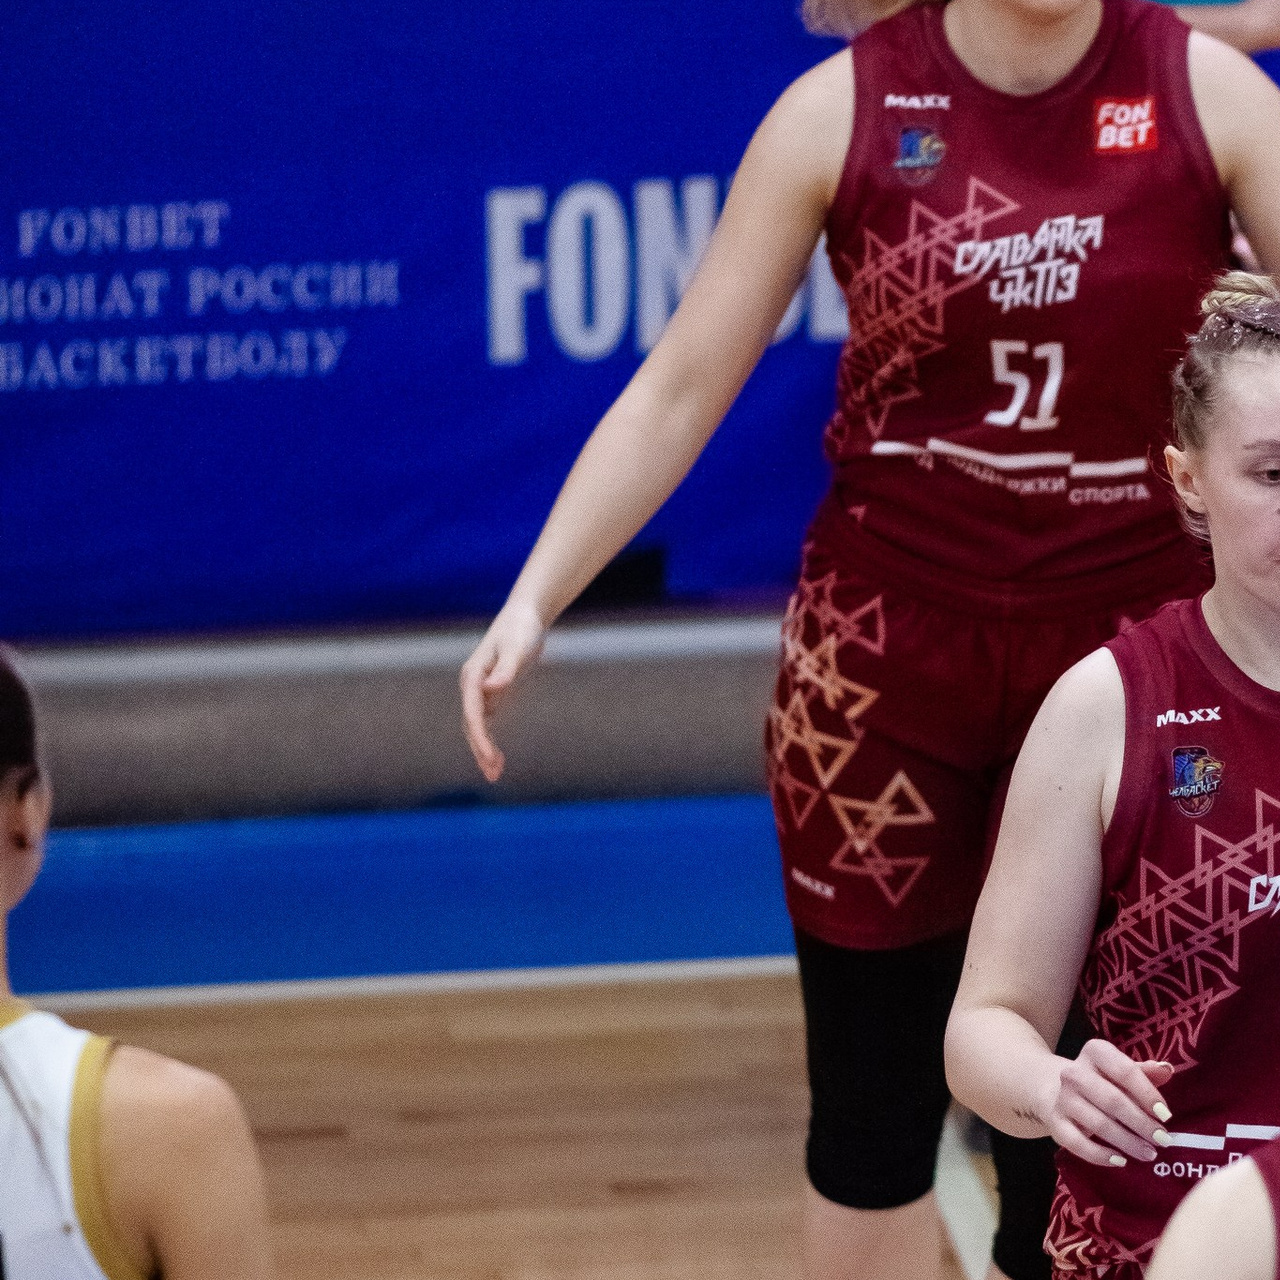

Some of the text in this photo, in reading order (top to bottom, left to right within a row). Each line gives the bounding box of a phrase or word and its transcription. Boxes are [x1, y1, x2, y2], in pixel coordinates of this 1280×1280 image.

[1098, 100, 1151, 125] FON
[1098, 121, 1152, 148] BET
[18, 200, 230, 258] FONBET
[188, 258, 400, 318] РОССИИ
[983, 339, 1064, 432] 51
[1156, 706, 1221, 727] MAXX
